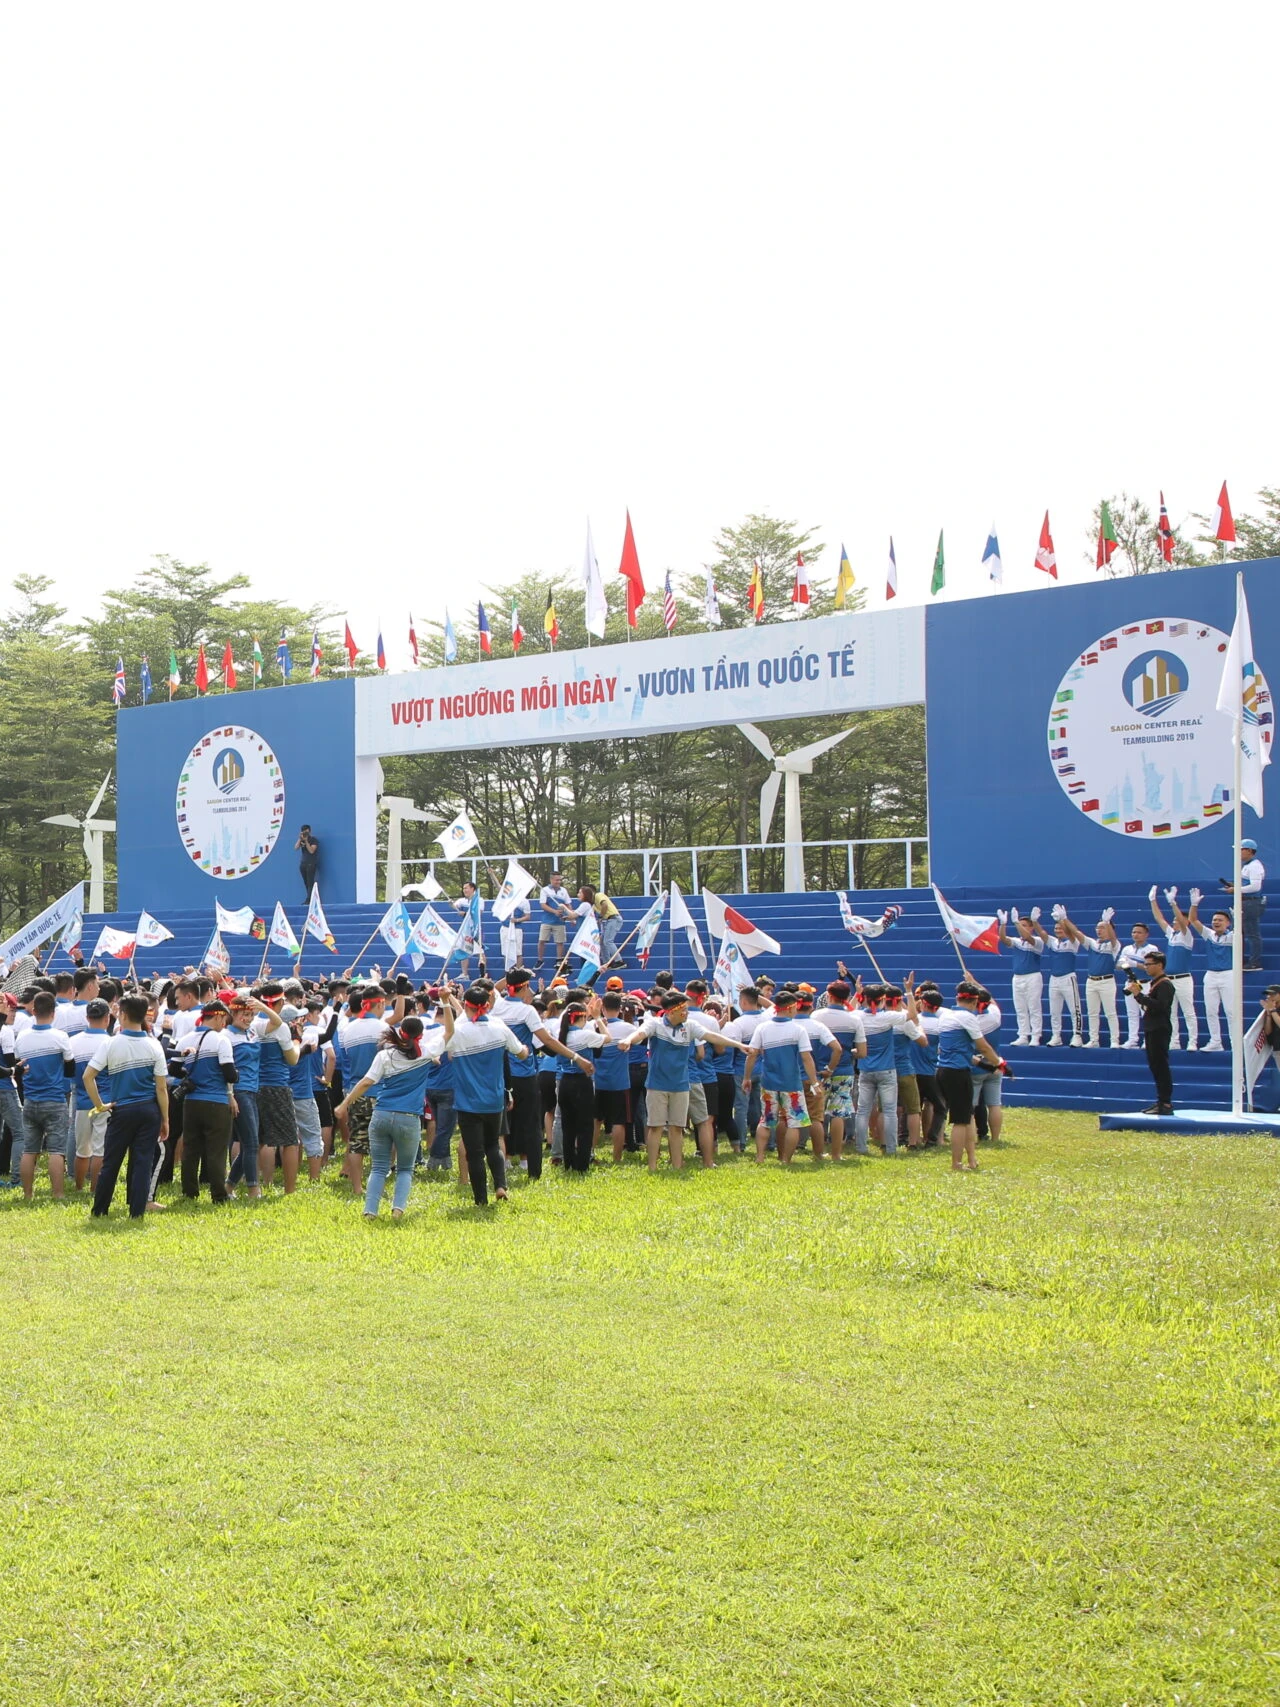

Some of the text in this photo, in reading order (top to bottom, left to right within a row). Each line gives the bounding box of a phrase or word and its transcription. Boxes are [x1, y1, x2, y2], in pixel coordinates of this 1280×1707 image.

[392, 697, 434, 728] VƯỢT
[439, 687, 515, 720] NGƯỠNG
[521, 676, 558, 712] MỖI
[564, 674, 618, 707] NGÀY
[638, 667, 695, 698] VƯƠN
[702, 655, 750, 692] TẦM
[757, 645, 820, 688] QUỐC
[827, 640, 857, 678] TẾ
[1110, 718, 1203, 733] SAIGON CENTER REAL
[1122, 732, 1195, 745] TEAMBUILDING 2019
